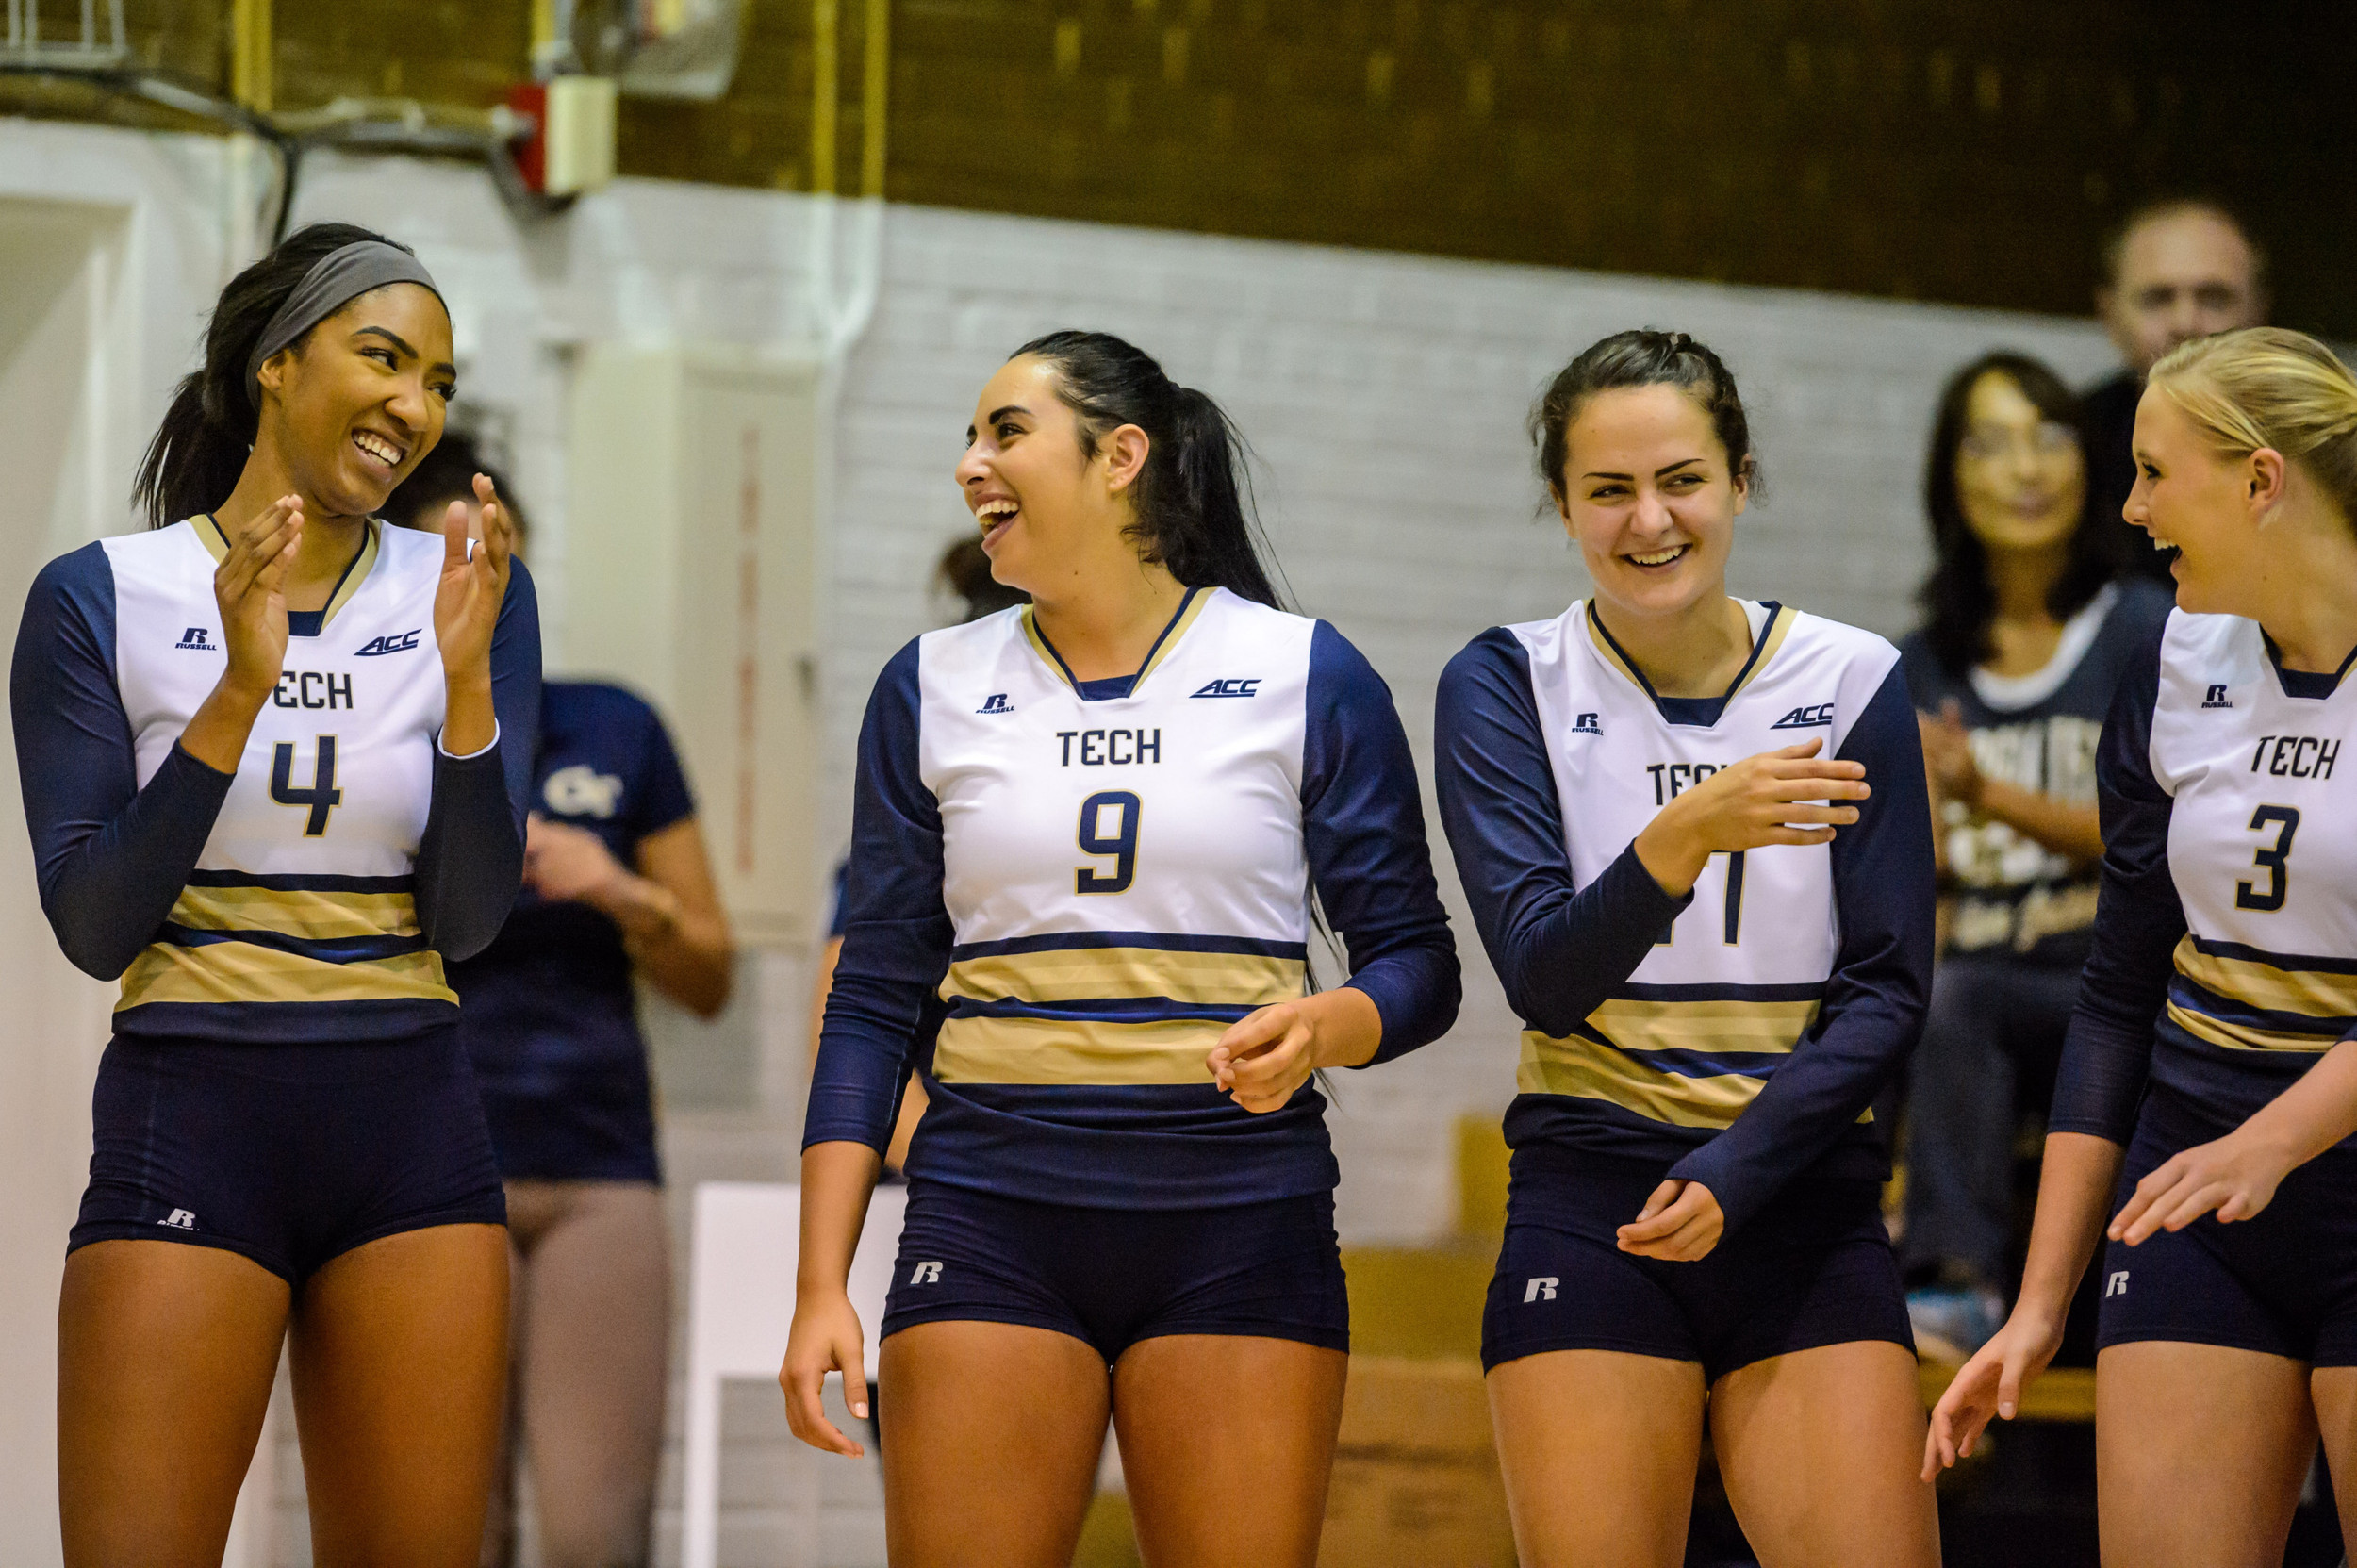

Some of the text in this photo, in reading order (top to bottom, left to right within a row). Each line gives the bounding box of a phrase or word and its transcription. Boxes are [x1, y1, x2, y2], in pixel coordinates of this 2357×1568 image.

[174, 642, 217, 651] RUSSELL
[354, 628, 422, 655] ACC
[272, 670, 354, 709] ECH
[1190, 678, 1262, 699] ACC
[975, 705, 1014, 715] RUSSELL
[1771, 702, 1835, 728] ACC
[1056, 728, 1162, 767] TECH
[2250, 734, 2342, 780] TECH
[268, 733, 344, 838] 4
[1646, 763, 1728, 806] TEC
[1075, 788, 1144, 897] 9
[2234, 802, 2302, 914] 3
[910, 1261, 944, 1285] R
[2105, 1270, 2130, 1298] R
[1524, 1277, 1559, 1303] R
